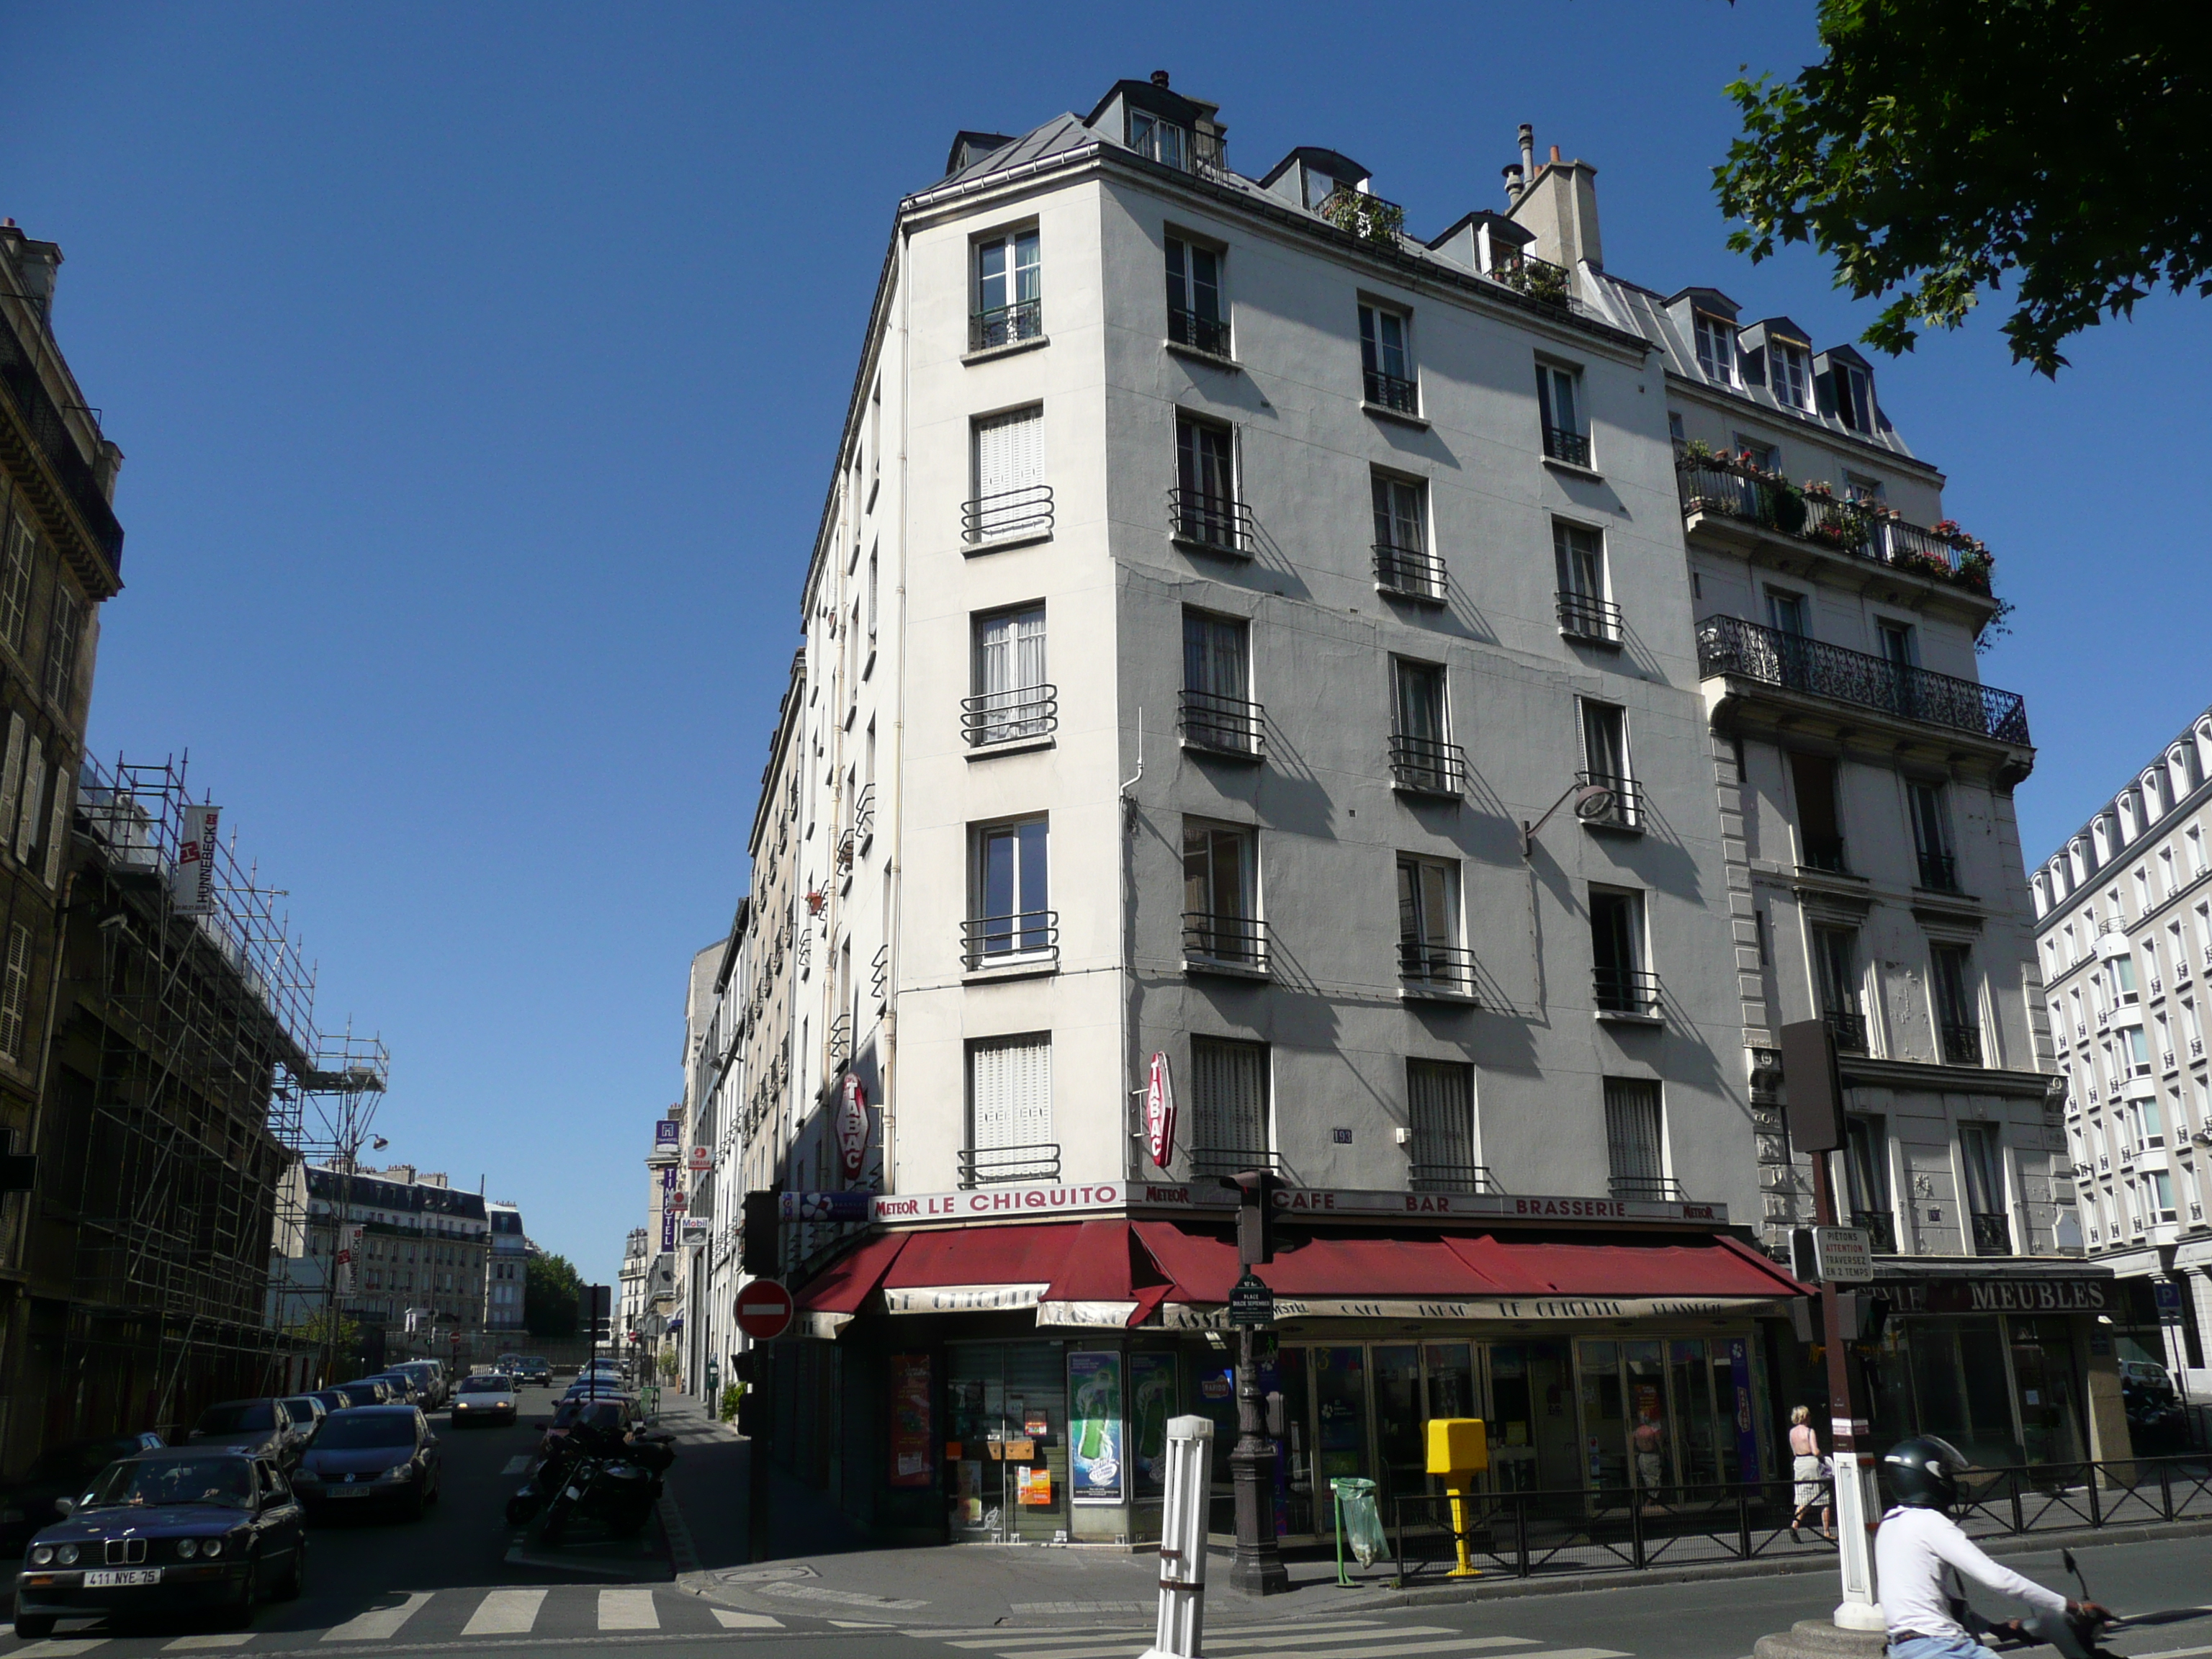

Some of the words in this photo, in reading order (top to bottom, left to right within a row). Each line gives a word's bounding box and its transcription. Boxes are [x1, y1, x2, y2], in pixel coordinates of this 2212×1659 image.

[1150, 1061, 1161, 1156] TABAC
[845, 1082, 860, 1169] TABAC
[1334, 1130, 1352, 1143] 193
[929, 1197, 955, 1214] LE
[970, 1186, 1117, 1211] CHIQUITO
[1272, 1191, 1334, 1210] CAFE
[1406, 1196, 1450, 1213] BAR
[1516, 1200, 1625, 1218] BRASSERIE
[682, 1218, 708, 1228] Mobil
[1826, 1244, 1863, 1254] ATTENTION
[1825, 1256, 1866, 1265] TRAVERSEZ
[1826, 1267, 1835, 1276] EN
[1838, 1268, 1843, 1277] 2
[1845, 1268, 1869, 1277] TEMPS
[890, 1294, 914, 1310] LE
[1968, 1280, 2105, 1310] MEUBLES
[1273, 1302, 1309, 1316] MSTEL
[1419, 1304, 1468, 1317] TABAC
[1499, 1302, 1524, 1317] LE
[1535, 1301, 1624, 1318] CHIQUITO
[90, 1573, 110, 1586] 411
[115, 1571, 136, 1584] NYE
[141, 1570, 156, 1583] 75
